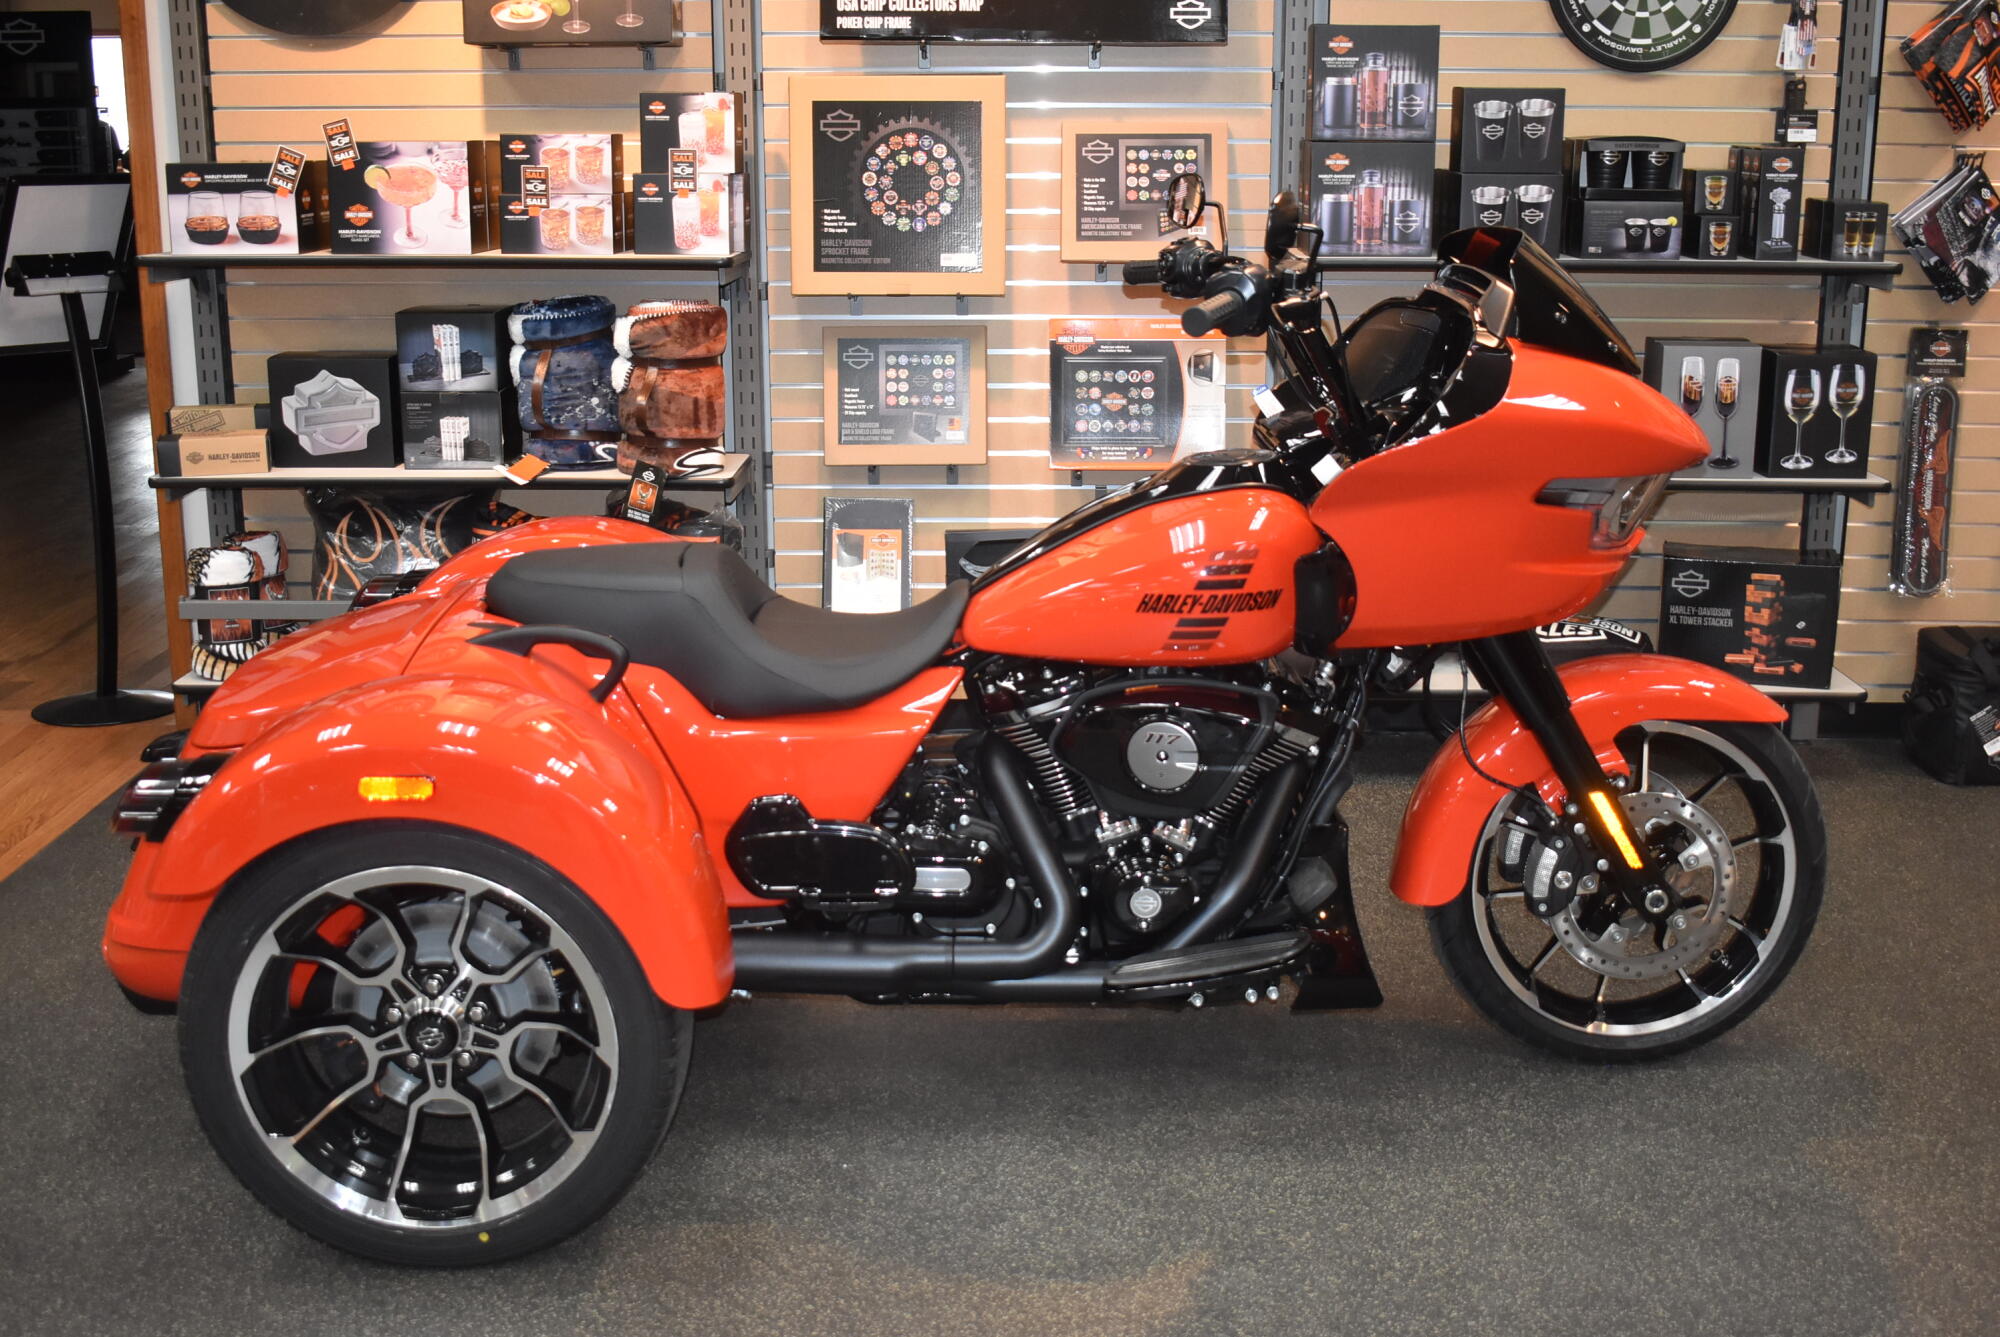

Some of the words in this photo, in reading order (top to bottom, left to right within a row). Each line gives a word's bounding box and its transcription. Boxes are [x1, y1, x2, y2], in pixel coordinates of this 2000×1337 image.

[836, 17, 863, 29] POKER
[863, 17, 884, 29] CHIP
[884, 17, 912, 29] FRAME
[333, 149, 356, 162] SALE
[271, 176, 294, 191] SALE
[673, 181, 695, 189] SALE
[526, 198, 548, 206] SALE
[207, 451, 261, 460] HARLEY-DAVIDSON
[1136, 587, 1283, 614] HARLEY-DAVIDSON
[1668, 605, 1732, 618] HARLEY-DAVIDSON
[1669, 615, 1678, 624] XL
[1679, 616, 1703, 626] TOWER
[1703, 617, 1734, 628] STACKER
[1145, 733, 1182, 746] 117
